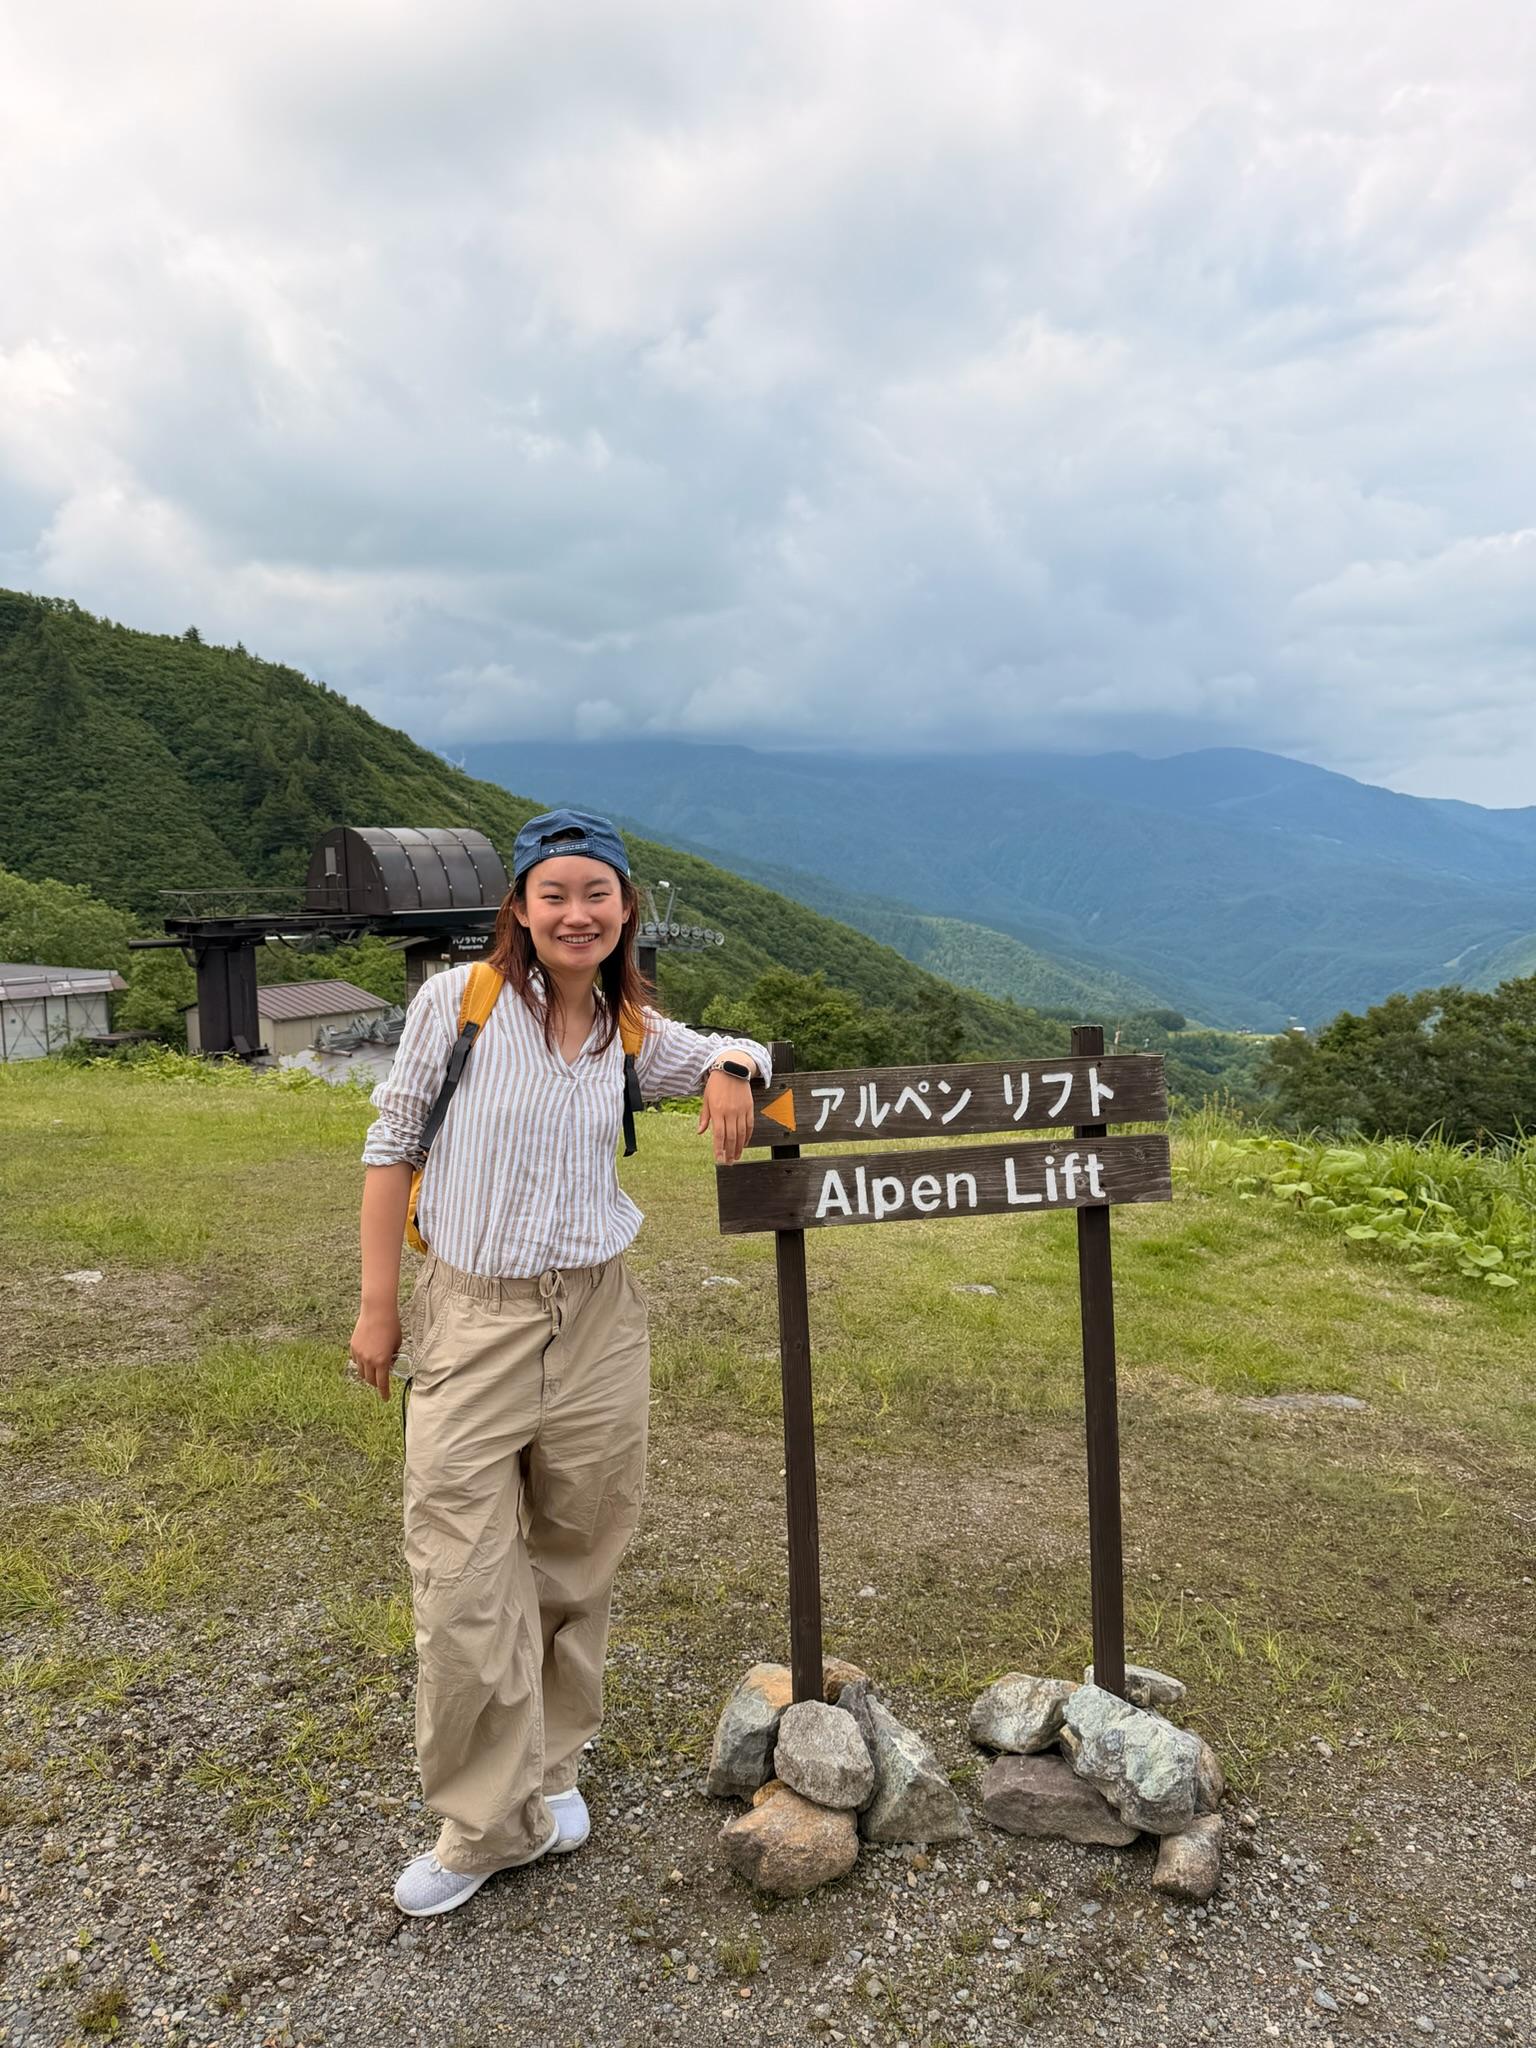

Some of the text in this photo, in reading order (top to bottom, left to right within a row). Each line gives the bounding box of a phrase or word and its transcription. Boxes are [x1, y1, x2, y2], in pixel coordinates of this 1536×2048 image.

[810, 1067, 1114, 1133] アルペン リフト
[815, 1152, 1107, 1220] Alpen Lift
